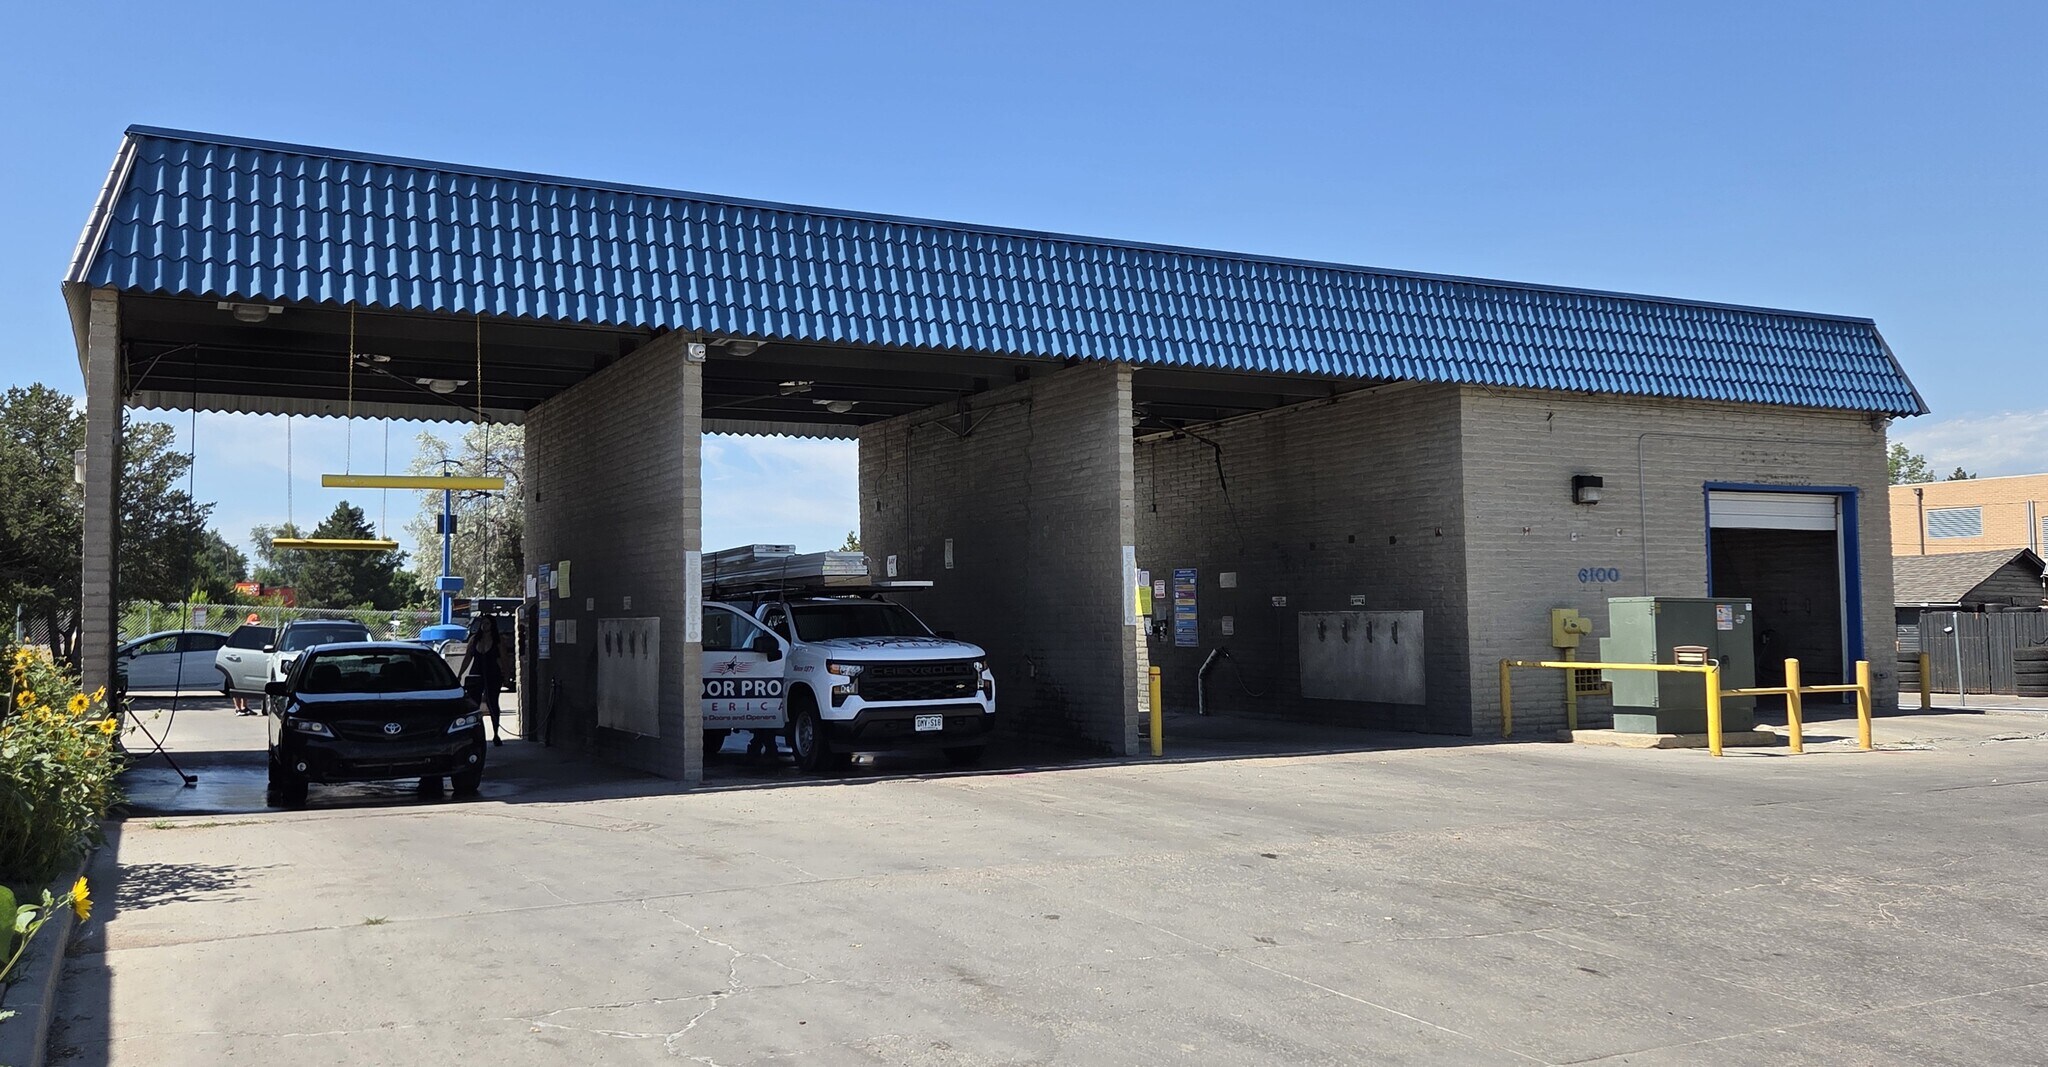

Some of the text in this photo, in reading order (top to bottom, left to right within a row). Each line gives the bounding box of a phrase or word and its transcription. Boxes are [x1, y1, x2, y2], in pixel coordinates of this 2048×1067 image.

[1578, 567, 1618, 583] 6100
[871, 664, 970, 676] CHEVROLET
[741, 679, 782, 696] PRO
